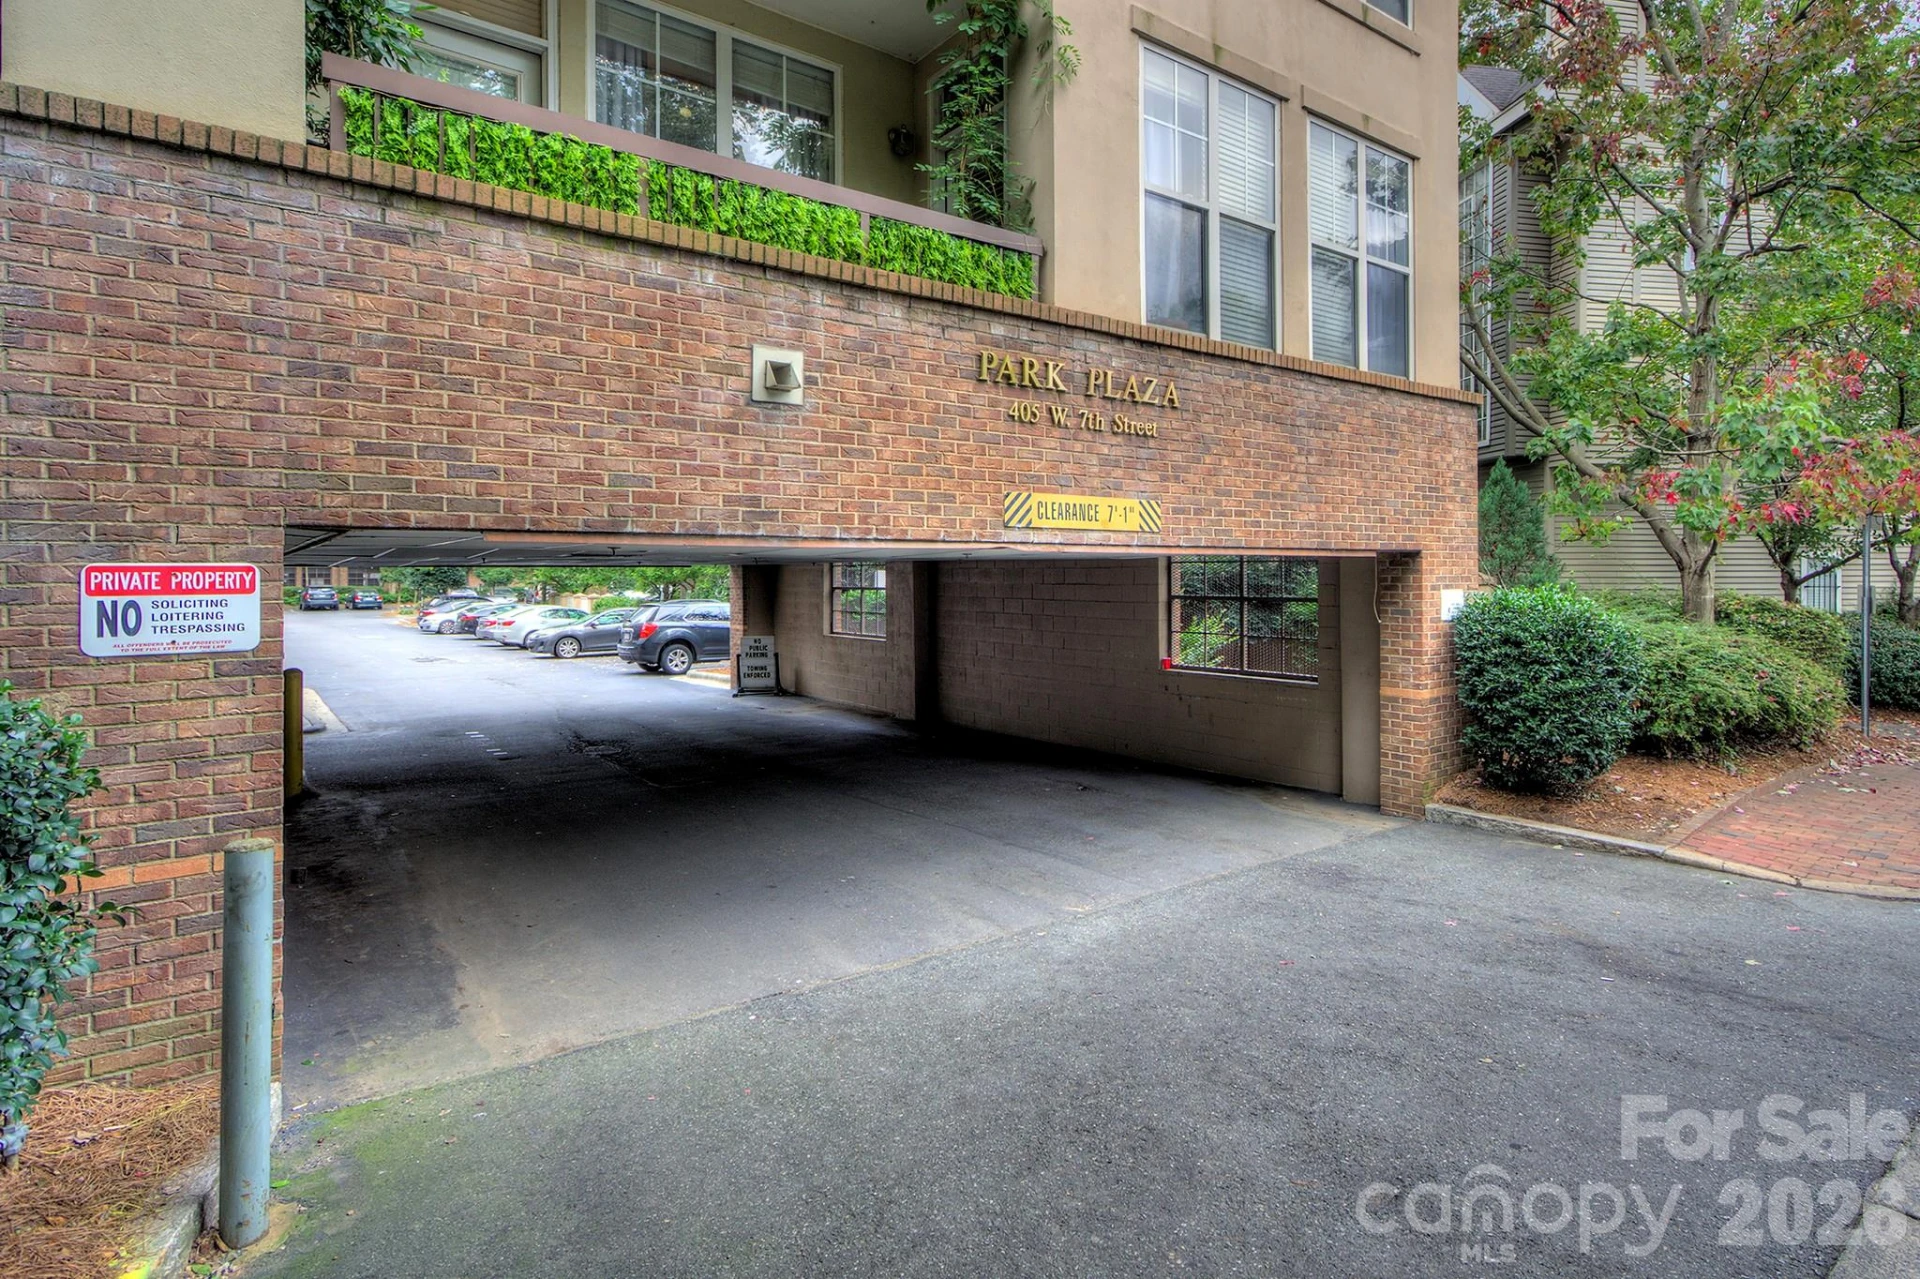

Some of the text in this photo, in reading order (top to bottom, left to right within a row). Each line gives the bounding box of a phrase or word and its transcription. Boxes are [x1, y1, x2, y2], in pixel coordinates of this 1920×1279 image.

[979, 350, 1180, 408] PARK PLAZA
[1008, 401, 1159, 438] 405 W. 7th Street
[1037, 500, 1100, 522] CLEARANCE
[90, 571, 253, 591] PRIVATE PROPERTY
[151, 598, 229, 610] SOLICITING
[96, 599, 142, 638] NO
[151, 611, 224, 622] LOITERING
[151, 623, 246, 635] TRESPASSING
